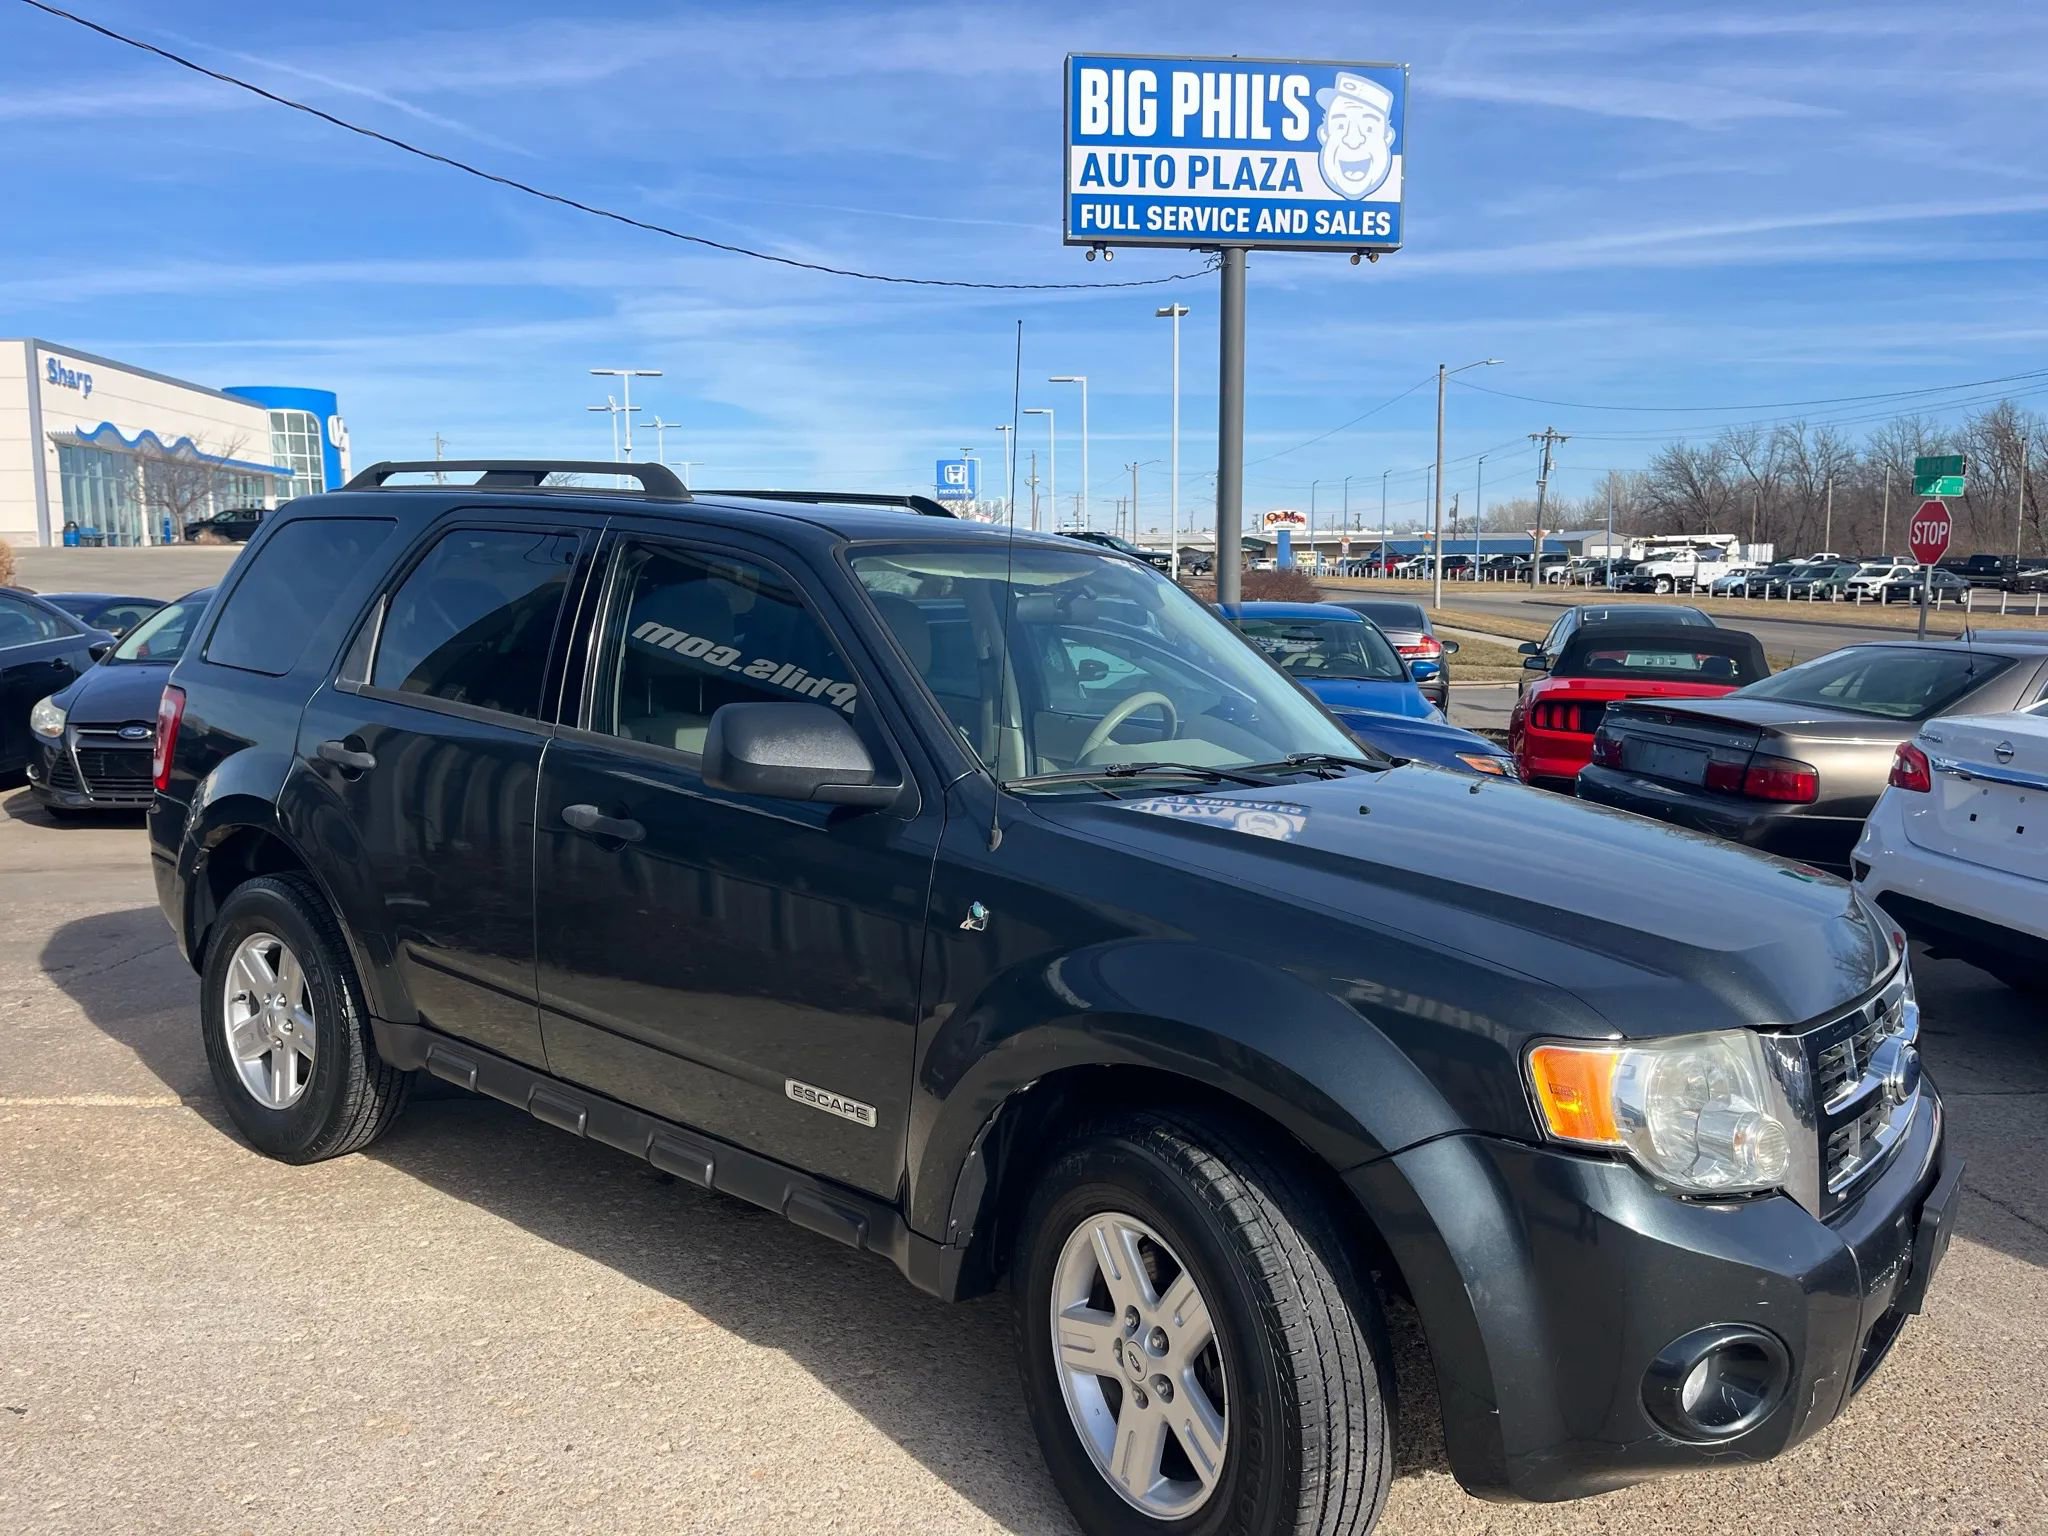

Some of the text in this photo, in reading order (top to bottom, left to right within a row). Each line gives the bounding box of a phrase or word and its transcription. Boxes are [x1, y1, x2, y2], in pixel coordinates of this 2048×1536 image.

[1080, 68, 1310, 141] BIG PHIL'S
[1079, 153, 1303, 192] AUTO PLAZA
[1080, 204, 1391, 236] FULL SERVICE AND SALES
[46, 357, 92, 400] Sharp
[1911, 521, 1948, 545] STOP
[793, 1084, 869, 1121] ESCAPE
